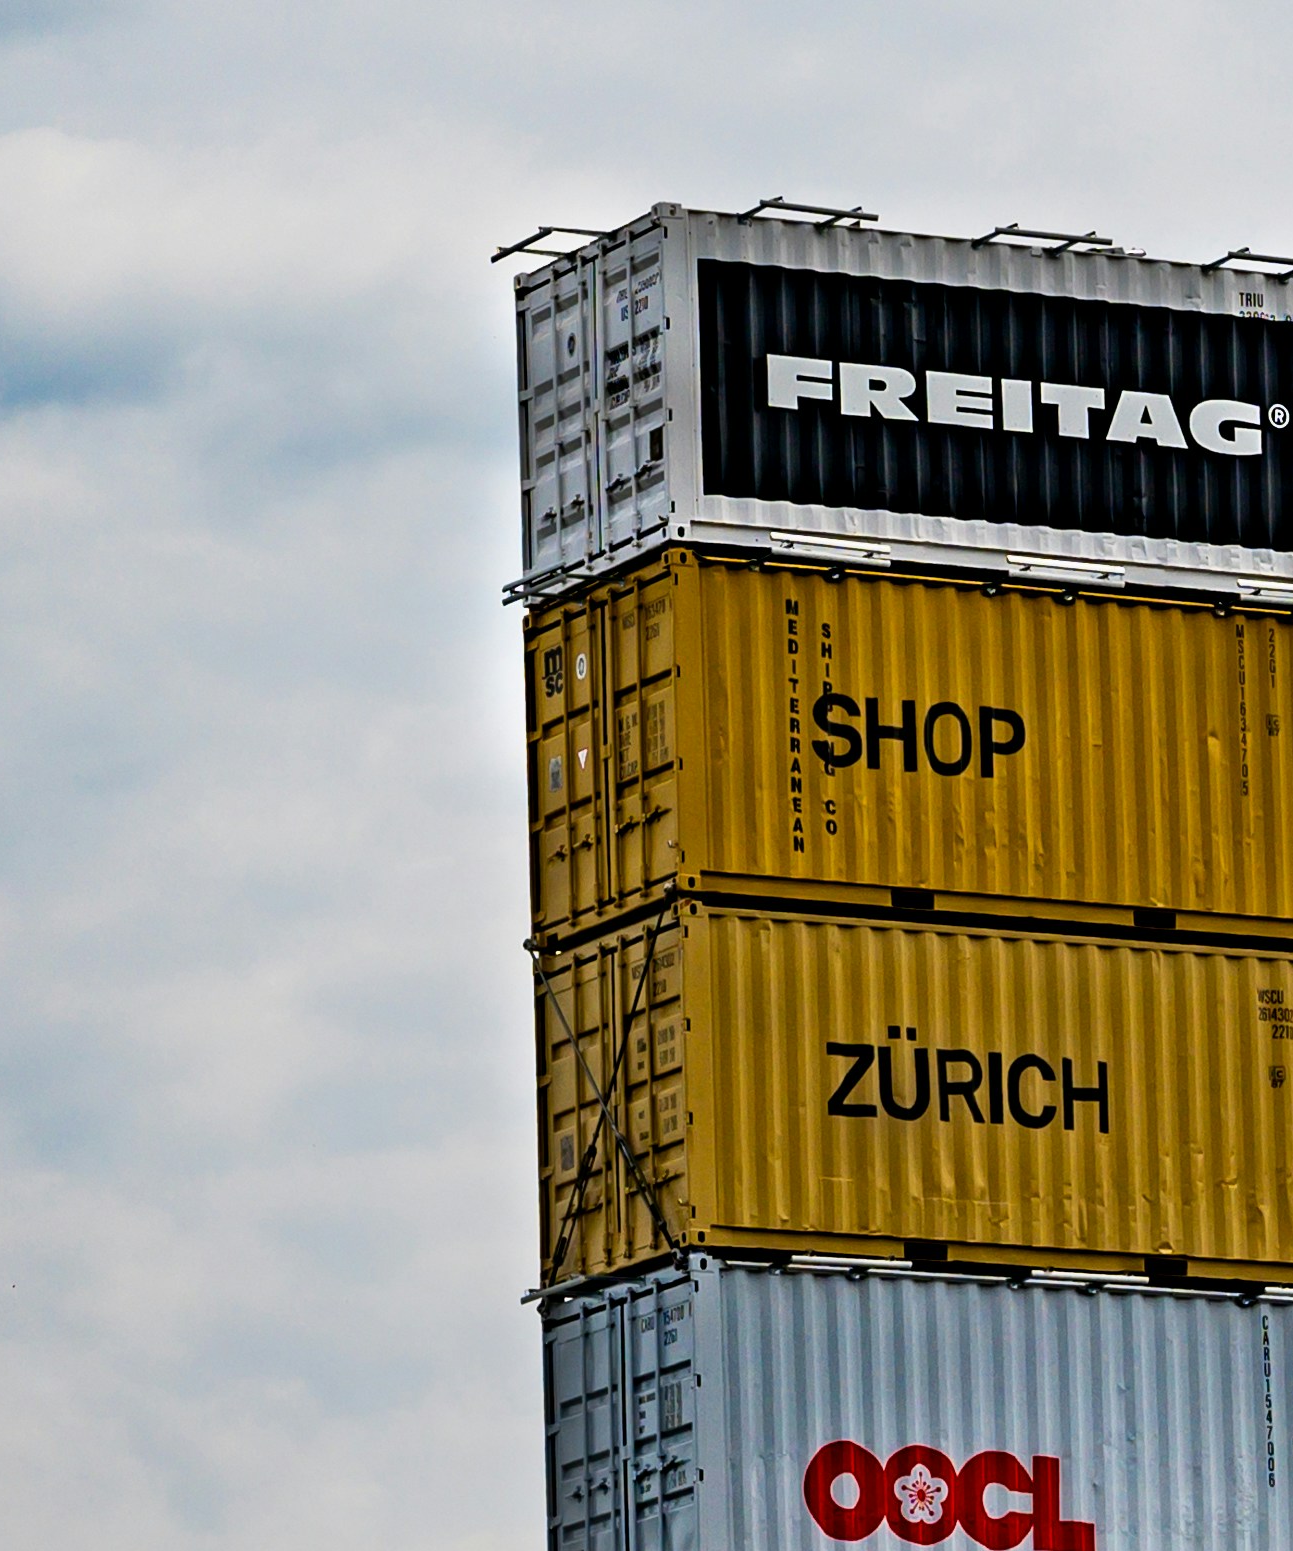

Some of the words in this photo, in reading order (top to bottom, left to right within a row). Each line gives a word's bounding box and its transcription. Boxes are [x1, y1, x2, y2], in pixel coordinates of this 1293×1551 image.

[1239, 292, 1264, 307] TRIU
[785, 599, 804, 853] MEDITERRANEAN
[812, 693, 1026, 778] SHOP
[824, 800, 837, 835] CO
[826, 1025, 1109, 1134] ZÜRICH
[1262, 1315, 1275, 1487] CARU1547006
